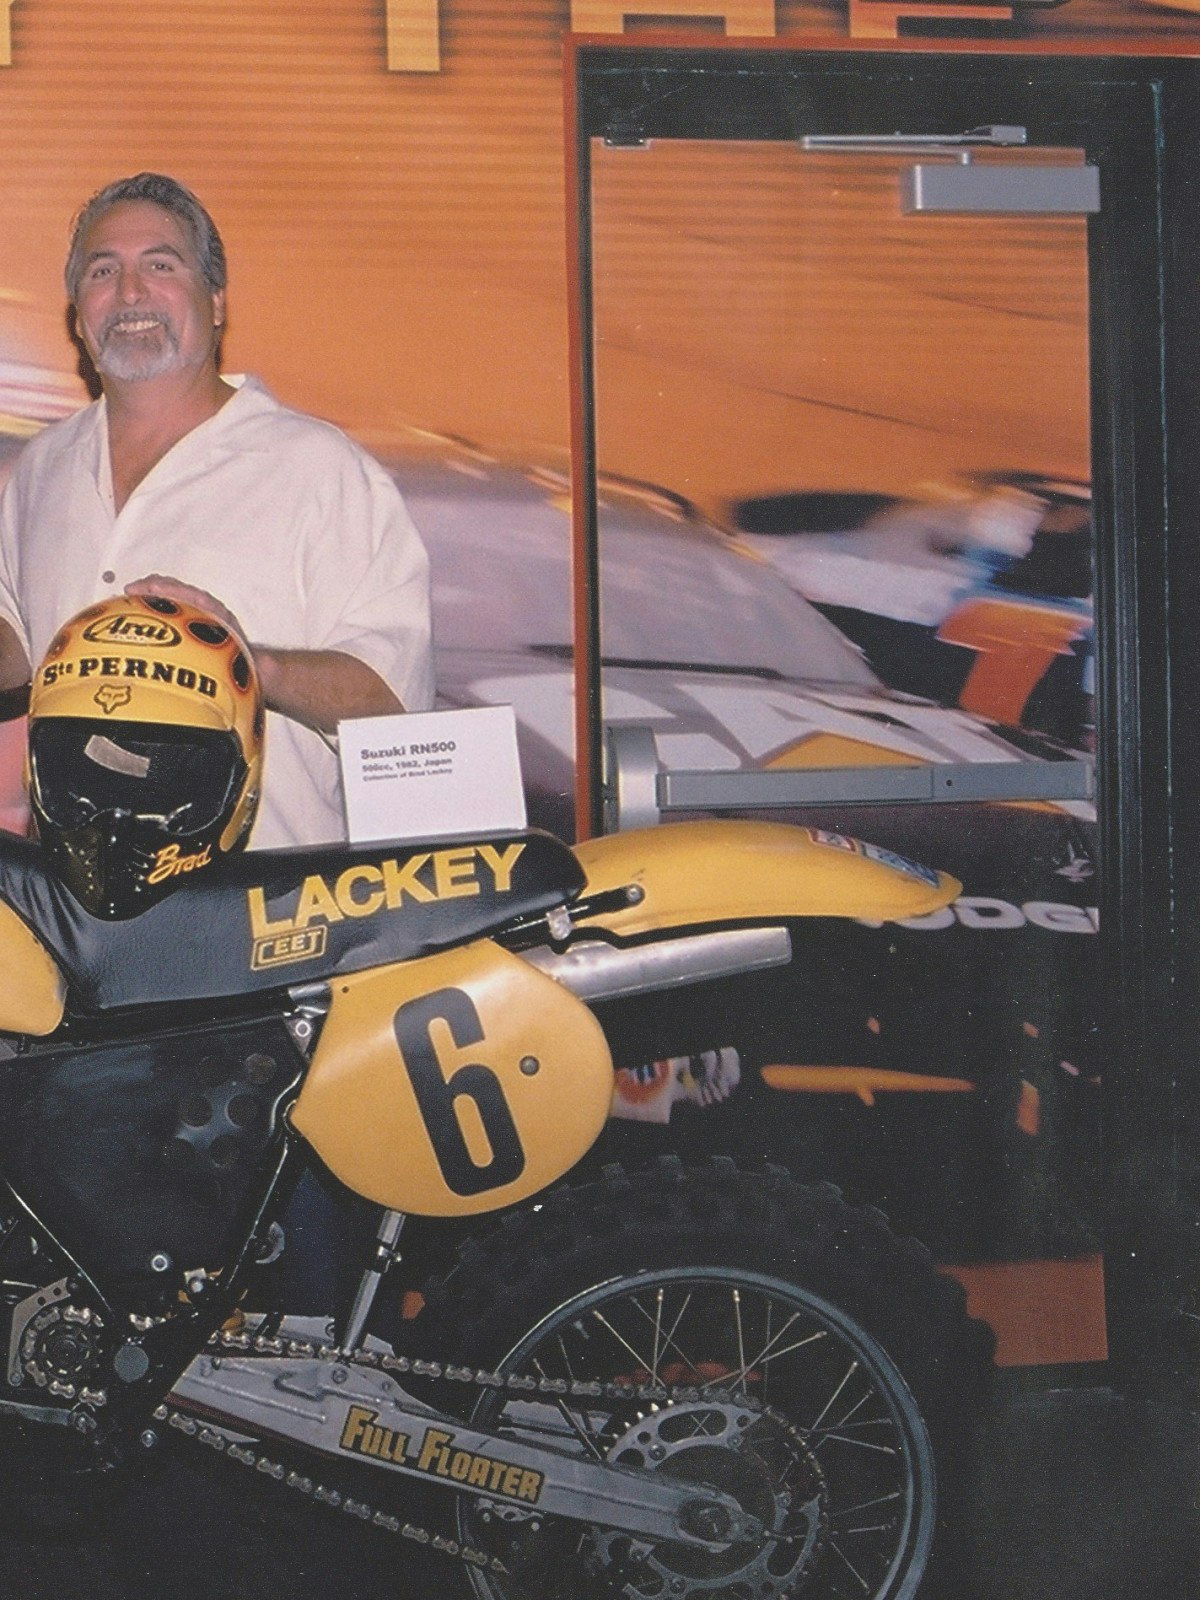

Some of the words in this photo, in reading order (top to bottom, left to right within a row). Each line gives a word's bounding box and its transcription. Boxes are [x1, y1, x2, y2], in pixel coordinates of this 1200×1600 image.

[91, 614, 169, 640] Arai
[78, 656, 218, 698] PERNOD
[360, 746, 406, 760] Suzuki
[409, 741, 456, 755] RN500
[423, 757, 453, 767] Japan
[147, 843, 212, 885] Brad
[247, 843, 527, 939] LACKEY
[394, 986, 526, 1197] 6
[339, 1405, 410, 1464] FULL
[417, 1426, 545, 1505] FLOATER
